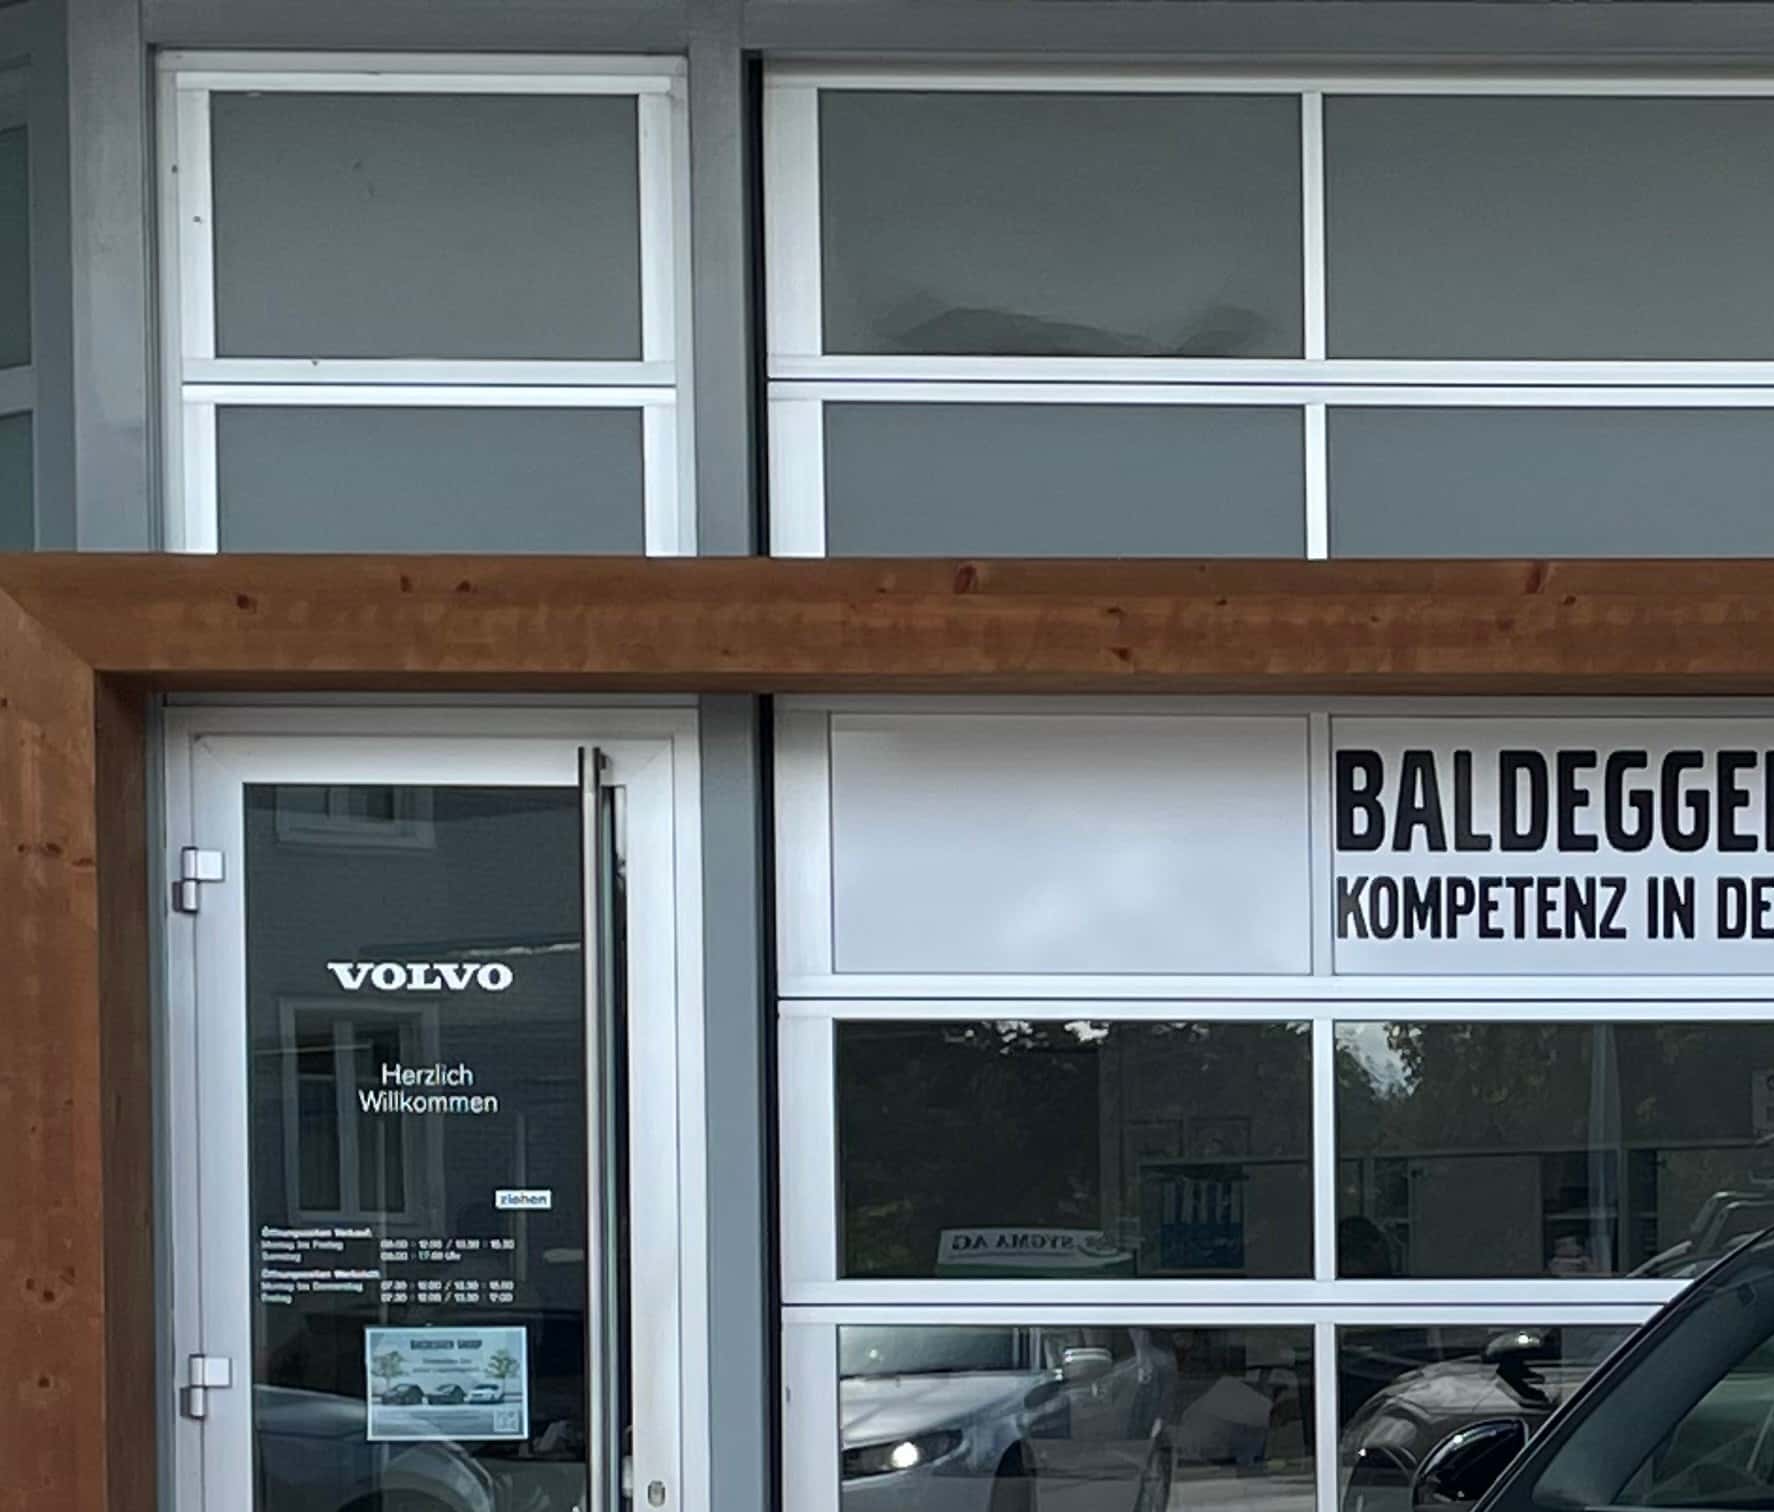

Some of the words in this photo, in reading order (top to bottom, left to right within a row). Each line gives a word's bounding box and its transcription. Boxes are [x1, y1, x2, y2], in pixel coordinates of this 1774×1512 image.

[1334, 874, 1628, 941] KOMPETENZ
[1648, 874, 1696, 941] IN
[327, 961, 514, 991] VOLVO
[381, 1063, 474, 1087] Herzlich
[359, 1090, 499, 1114] Willkommen
